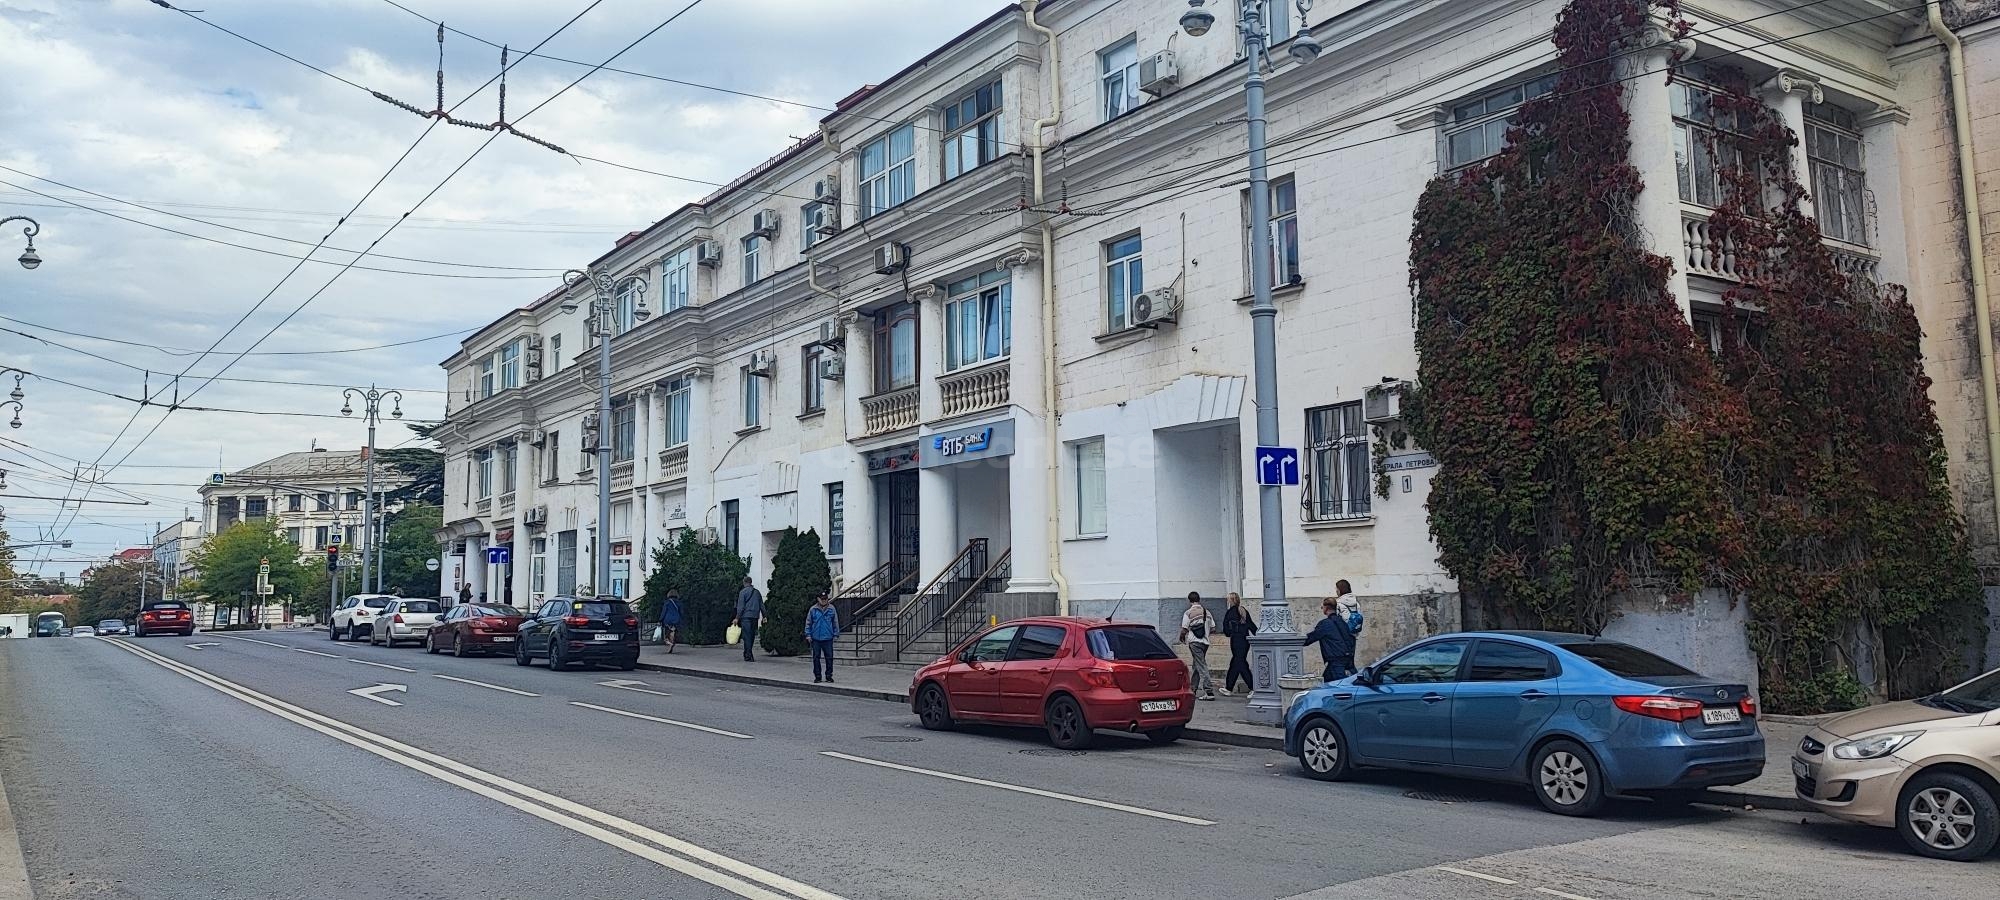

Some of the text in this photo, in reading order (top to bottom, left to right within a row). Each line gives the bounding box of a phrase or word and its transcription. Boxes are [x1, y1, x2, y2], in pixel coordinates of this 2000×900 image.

[942, 432, 983, 456] ВТБ БАНК
[1406, 459, 1435, 467] ПЕТРОВА
[1404, 478, 1409, 489] 1
